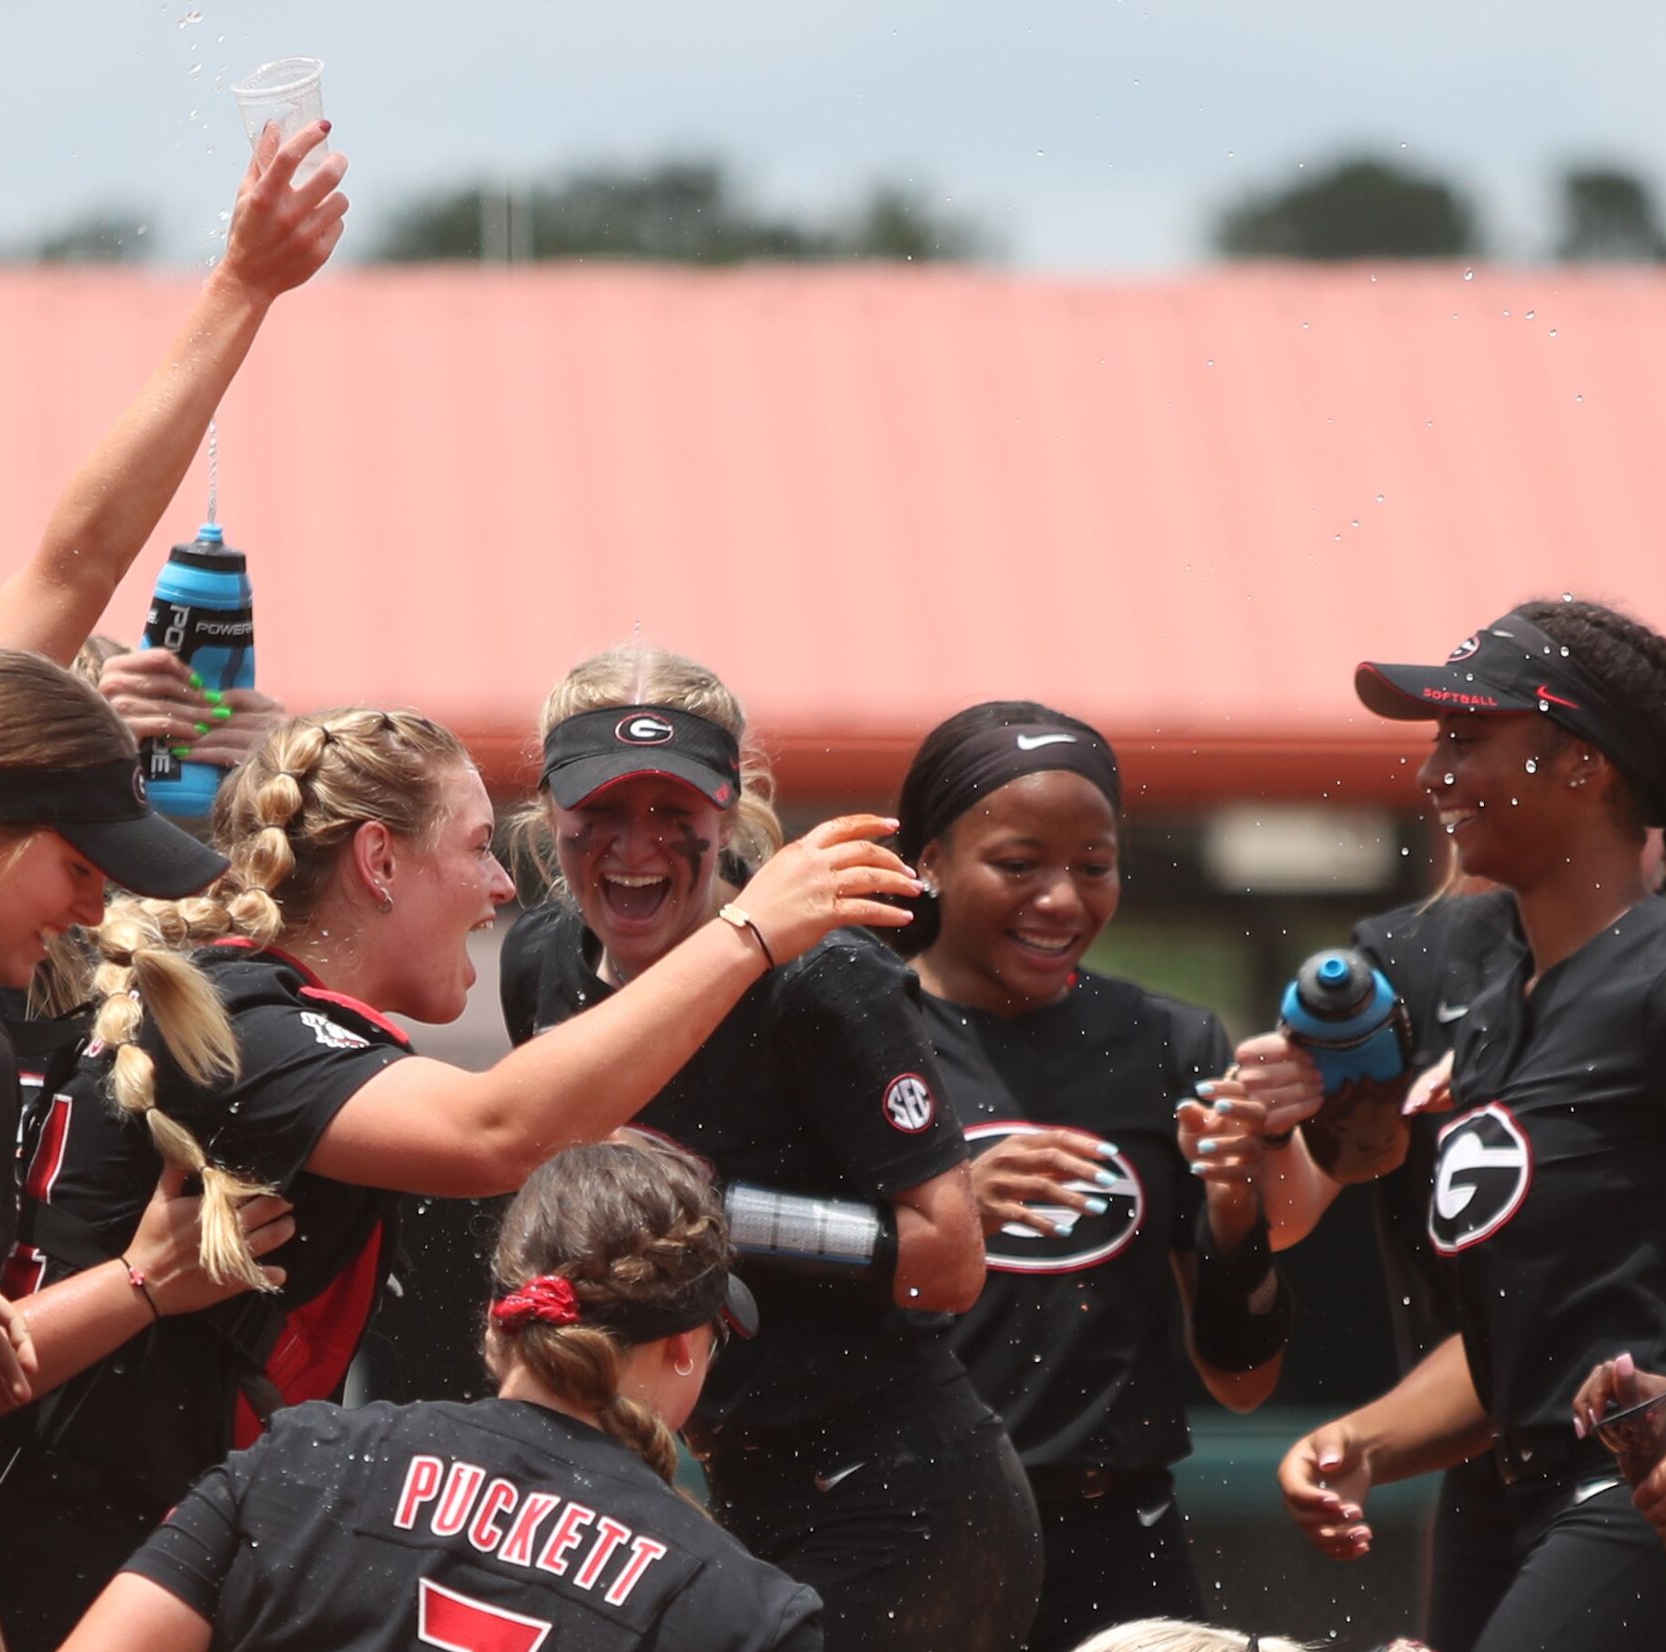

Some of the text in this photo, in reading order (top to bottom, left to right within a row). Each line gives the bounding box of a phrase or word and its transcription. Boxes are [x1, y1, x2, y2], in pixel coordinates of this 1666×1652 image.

[1422, 687, 1498, 706] SOFTBALL
[887, 1077, 932, 1130] SEC
[393, 1455, 668, 1607] PUCKETT
